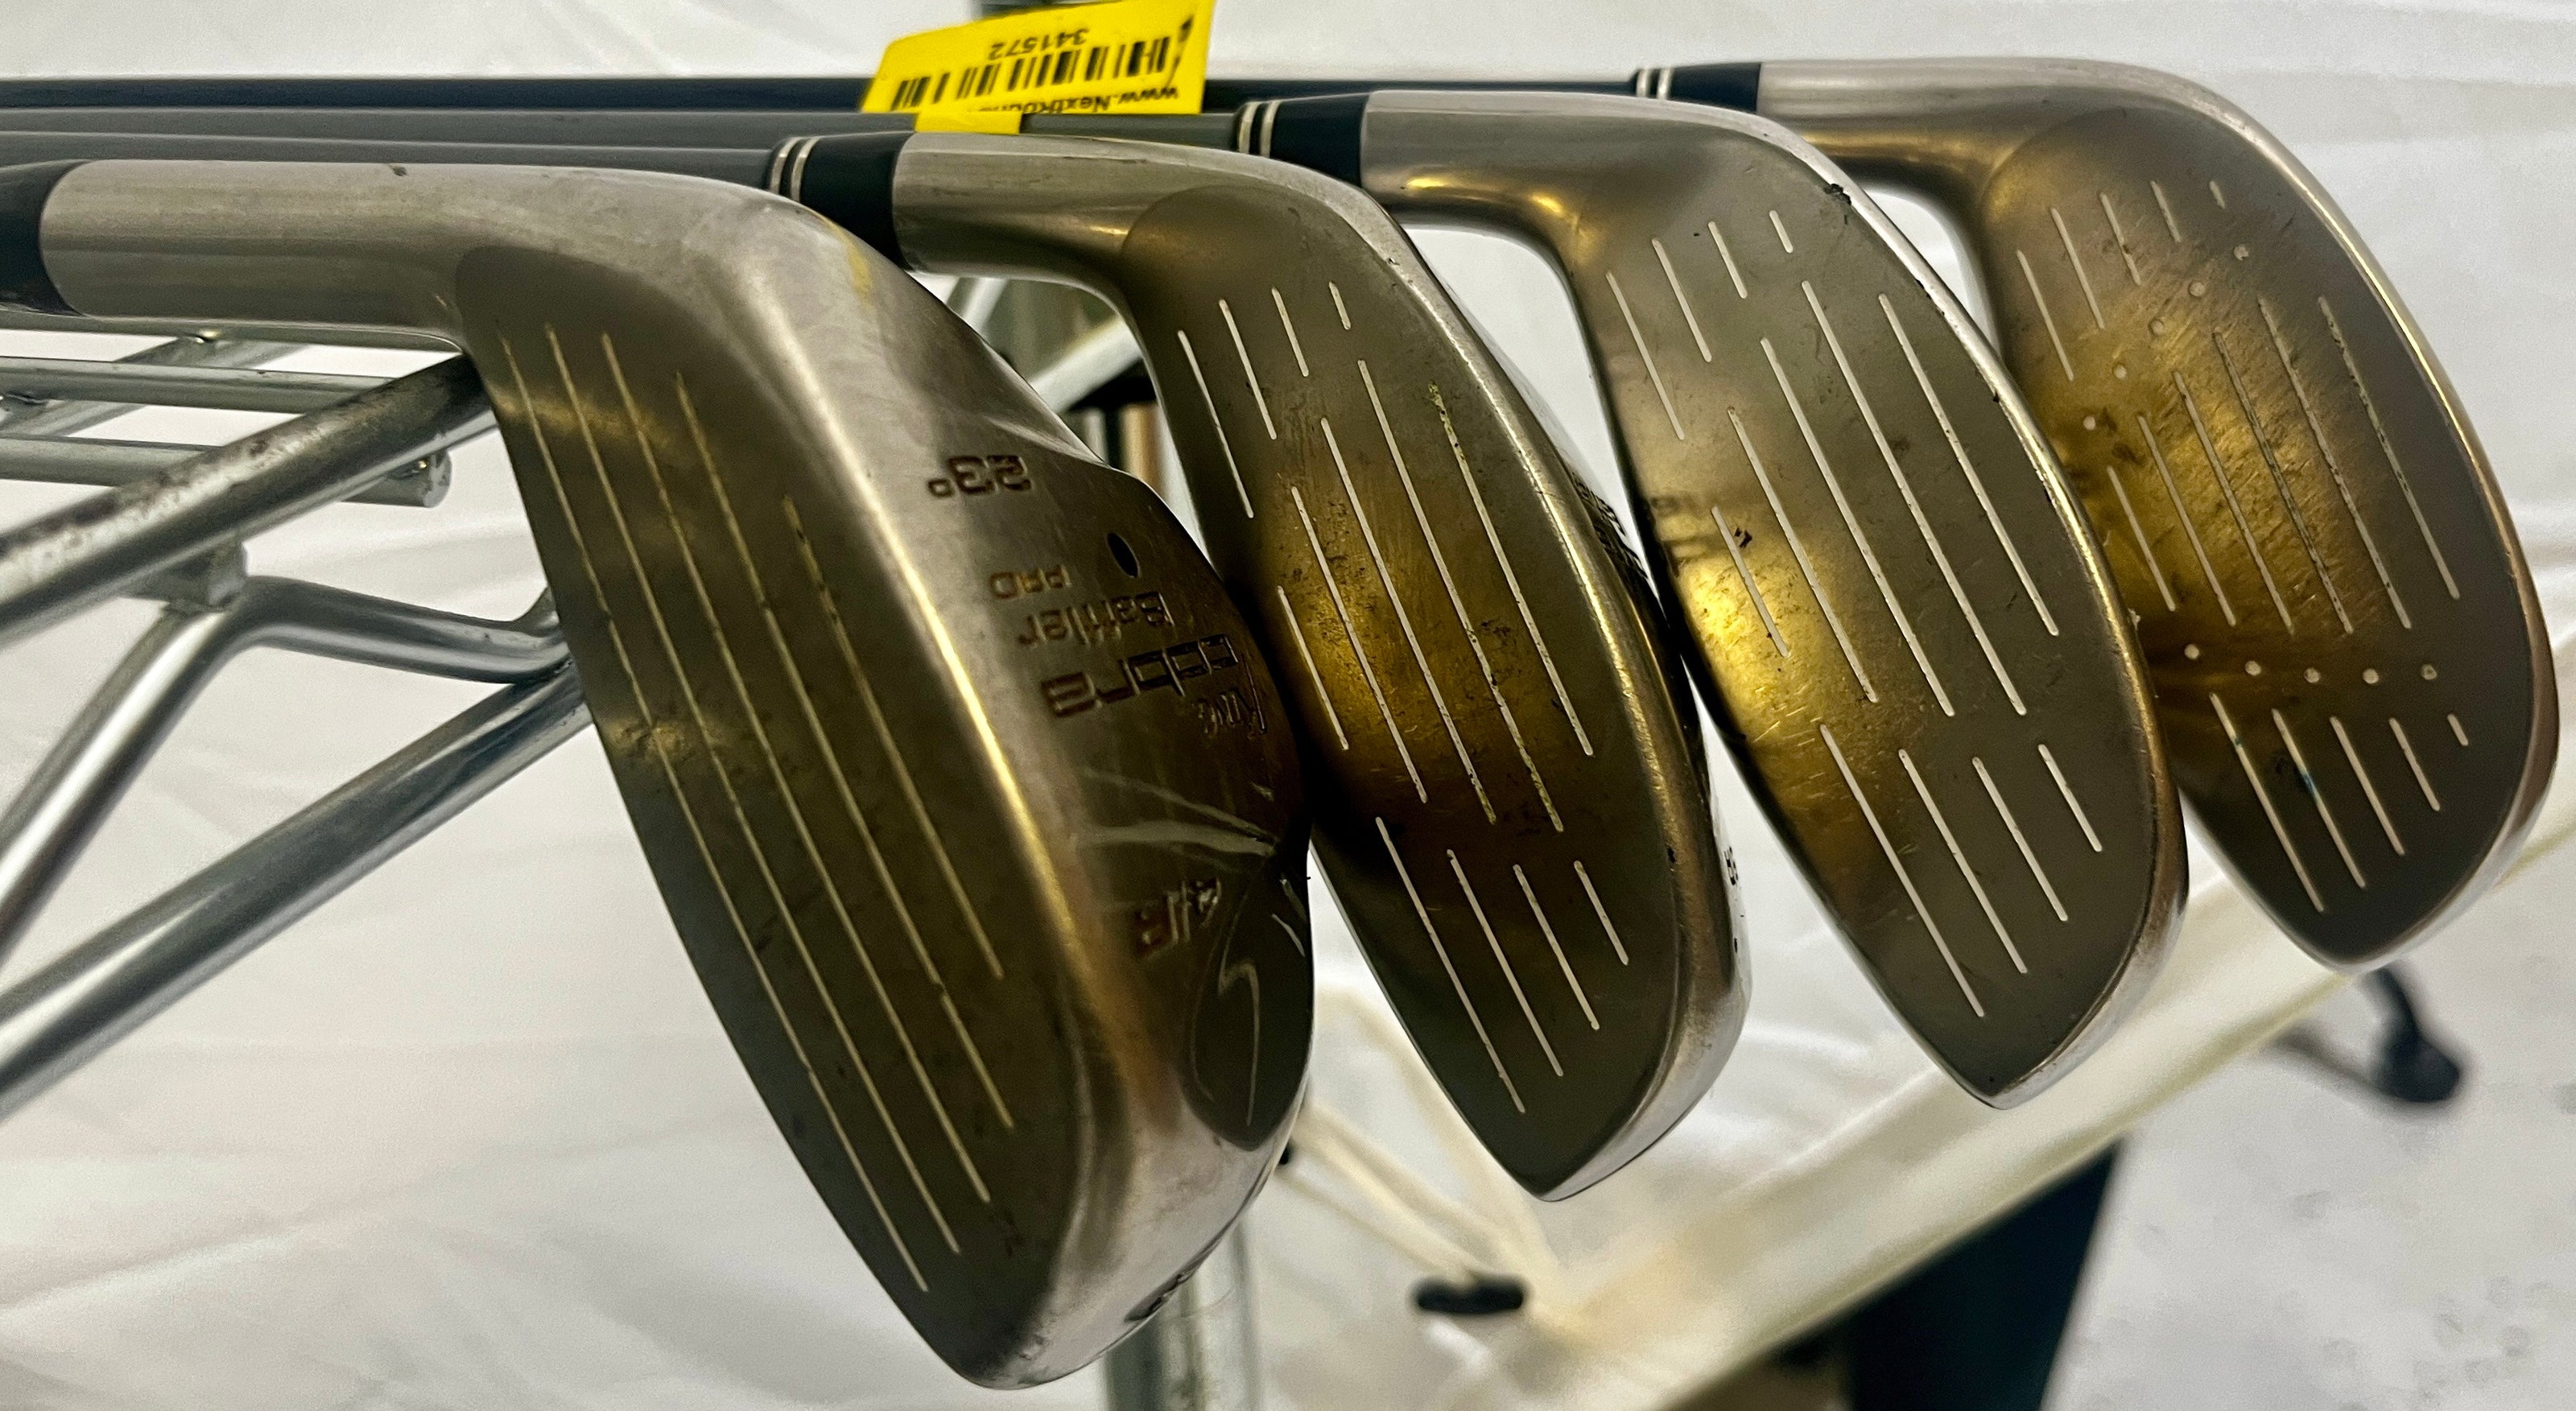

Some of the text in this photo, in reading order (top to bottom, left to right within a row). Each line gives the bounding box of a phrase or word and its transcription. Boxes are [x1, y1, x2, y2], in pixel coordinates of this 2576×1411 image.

[988, 27, 1090, 60] 341572
[989, 564, 1072, 600] PRO
[1018, 592, 1175, 649] Baffler
